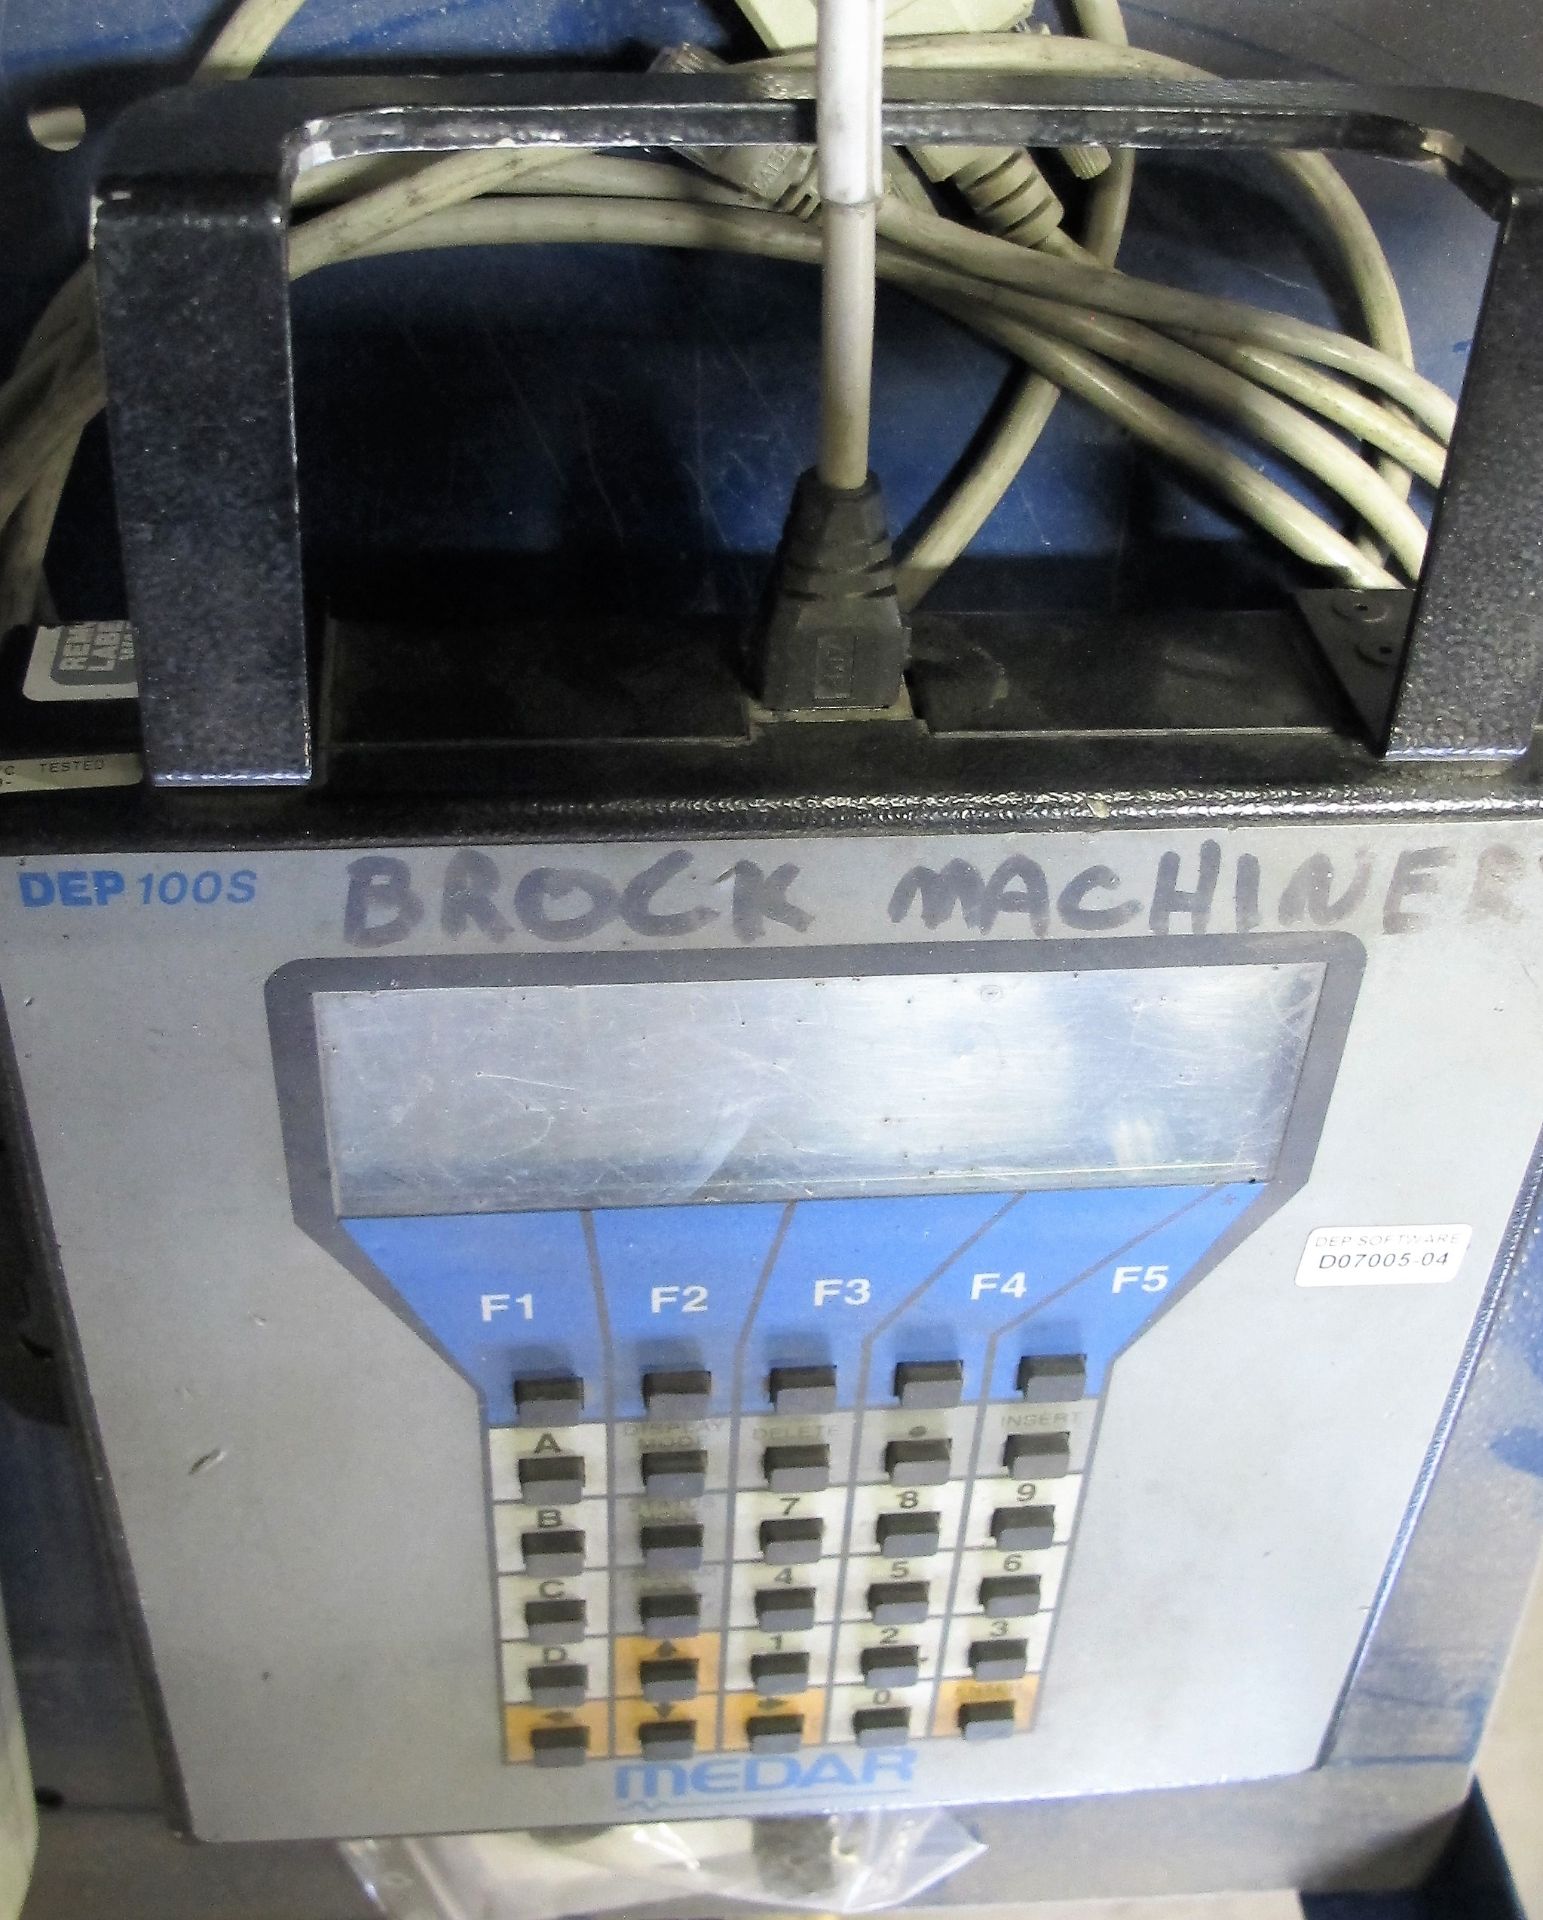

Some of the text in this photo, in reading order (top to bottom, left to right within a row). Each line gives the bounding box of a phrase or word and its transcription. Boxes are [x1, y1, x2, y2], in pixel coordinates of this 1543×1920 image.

[39, 758, 104, 774] TESTED
[19, 870, 258, 908] DEP 100S
[343, 839, 1543, 946] BROCK MACHINER
[1315, 1232, 1462, 1248] DEP SOFTWARE
[970, 1271, 1029, 1300] F4
[1111, 1265, 1170, 1294] F5
[650, 1286, 710, 1314] F2
[813, 1278, 873, 1307] F3
[480, 1294, 535, 1322] F1
[1000, 1410, 1084, 1428] INSERT
[752, 1424, 841, 1441] DELETE
[533, 1433, 562, 1454] A
[898, 1490, 920, 1510] 8
[1015, 1483, 1037, 1502] 9
[781, 1497, 801, 1517] 7
[538, 1509, 564, 1529] B
[890, 1560, 911, 1578] 5
[1003, 1554, 1024, 1572] 6
[773, 1568, 795, 1585] 4
[538, 1580, 565, 1600] C
[879, 1628, 900, 1646] 2
[989, 1621, 1010, 1639] 3
[770, 1635, 784, 1650] 1
[541, 1646, 568, 1664] D
[872, 1690, 892, 1706] 0
[616, 1748, 916, 1799] MEDAR
